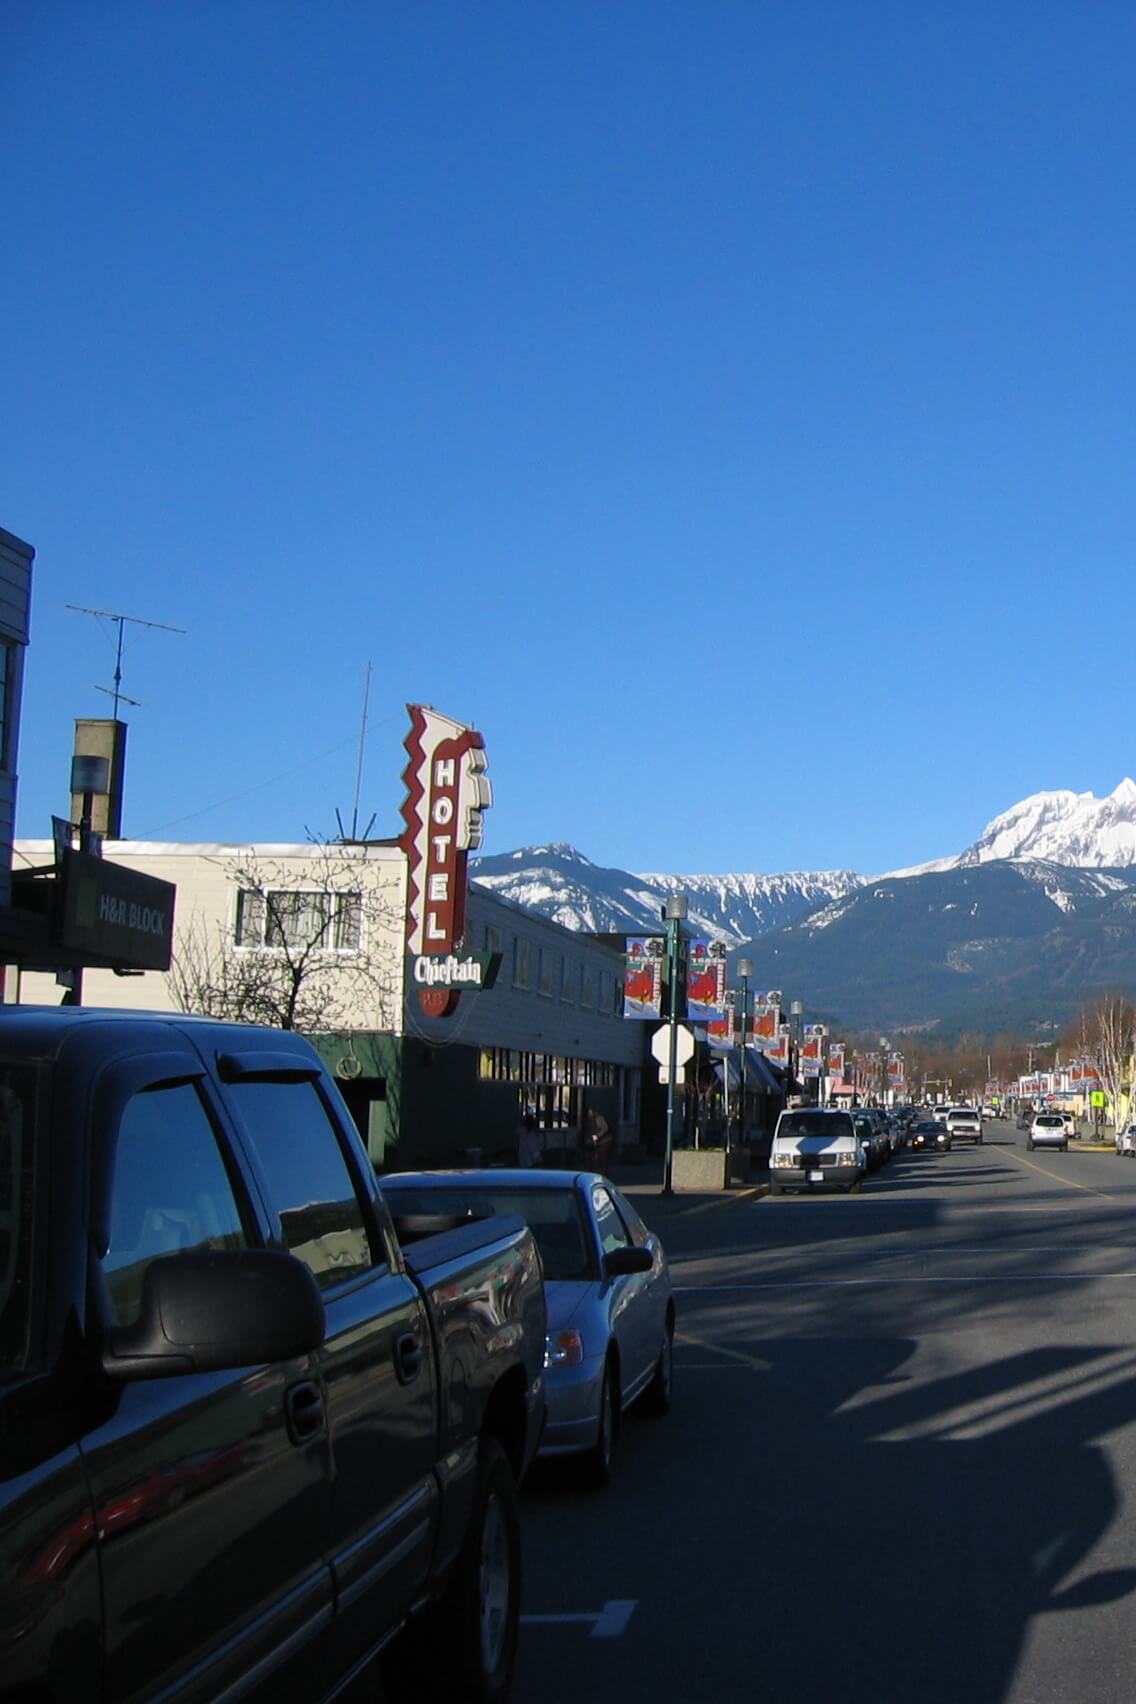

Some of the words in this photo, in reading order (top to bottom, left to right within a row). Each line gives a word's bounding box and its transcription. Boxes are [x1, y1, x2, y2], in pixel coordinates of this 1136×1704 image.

[427, 758, 455, 940] HOTEL
[100, 895, 126, 926] H&R
[128, 903, 165, 936] BLOCK
[414, 955, 482, 986] Chieftain
